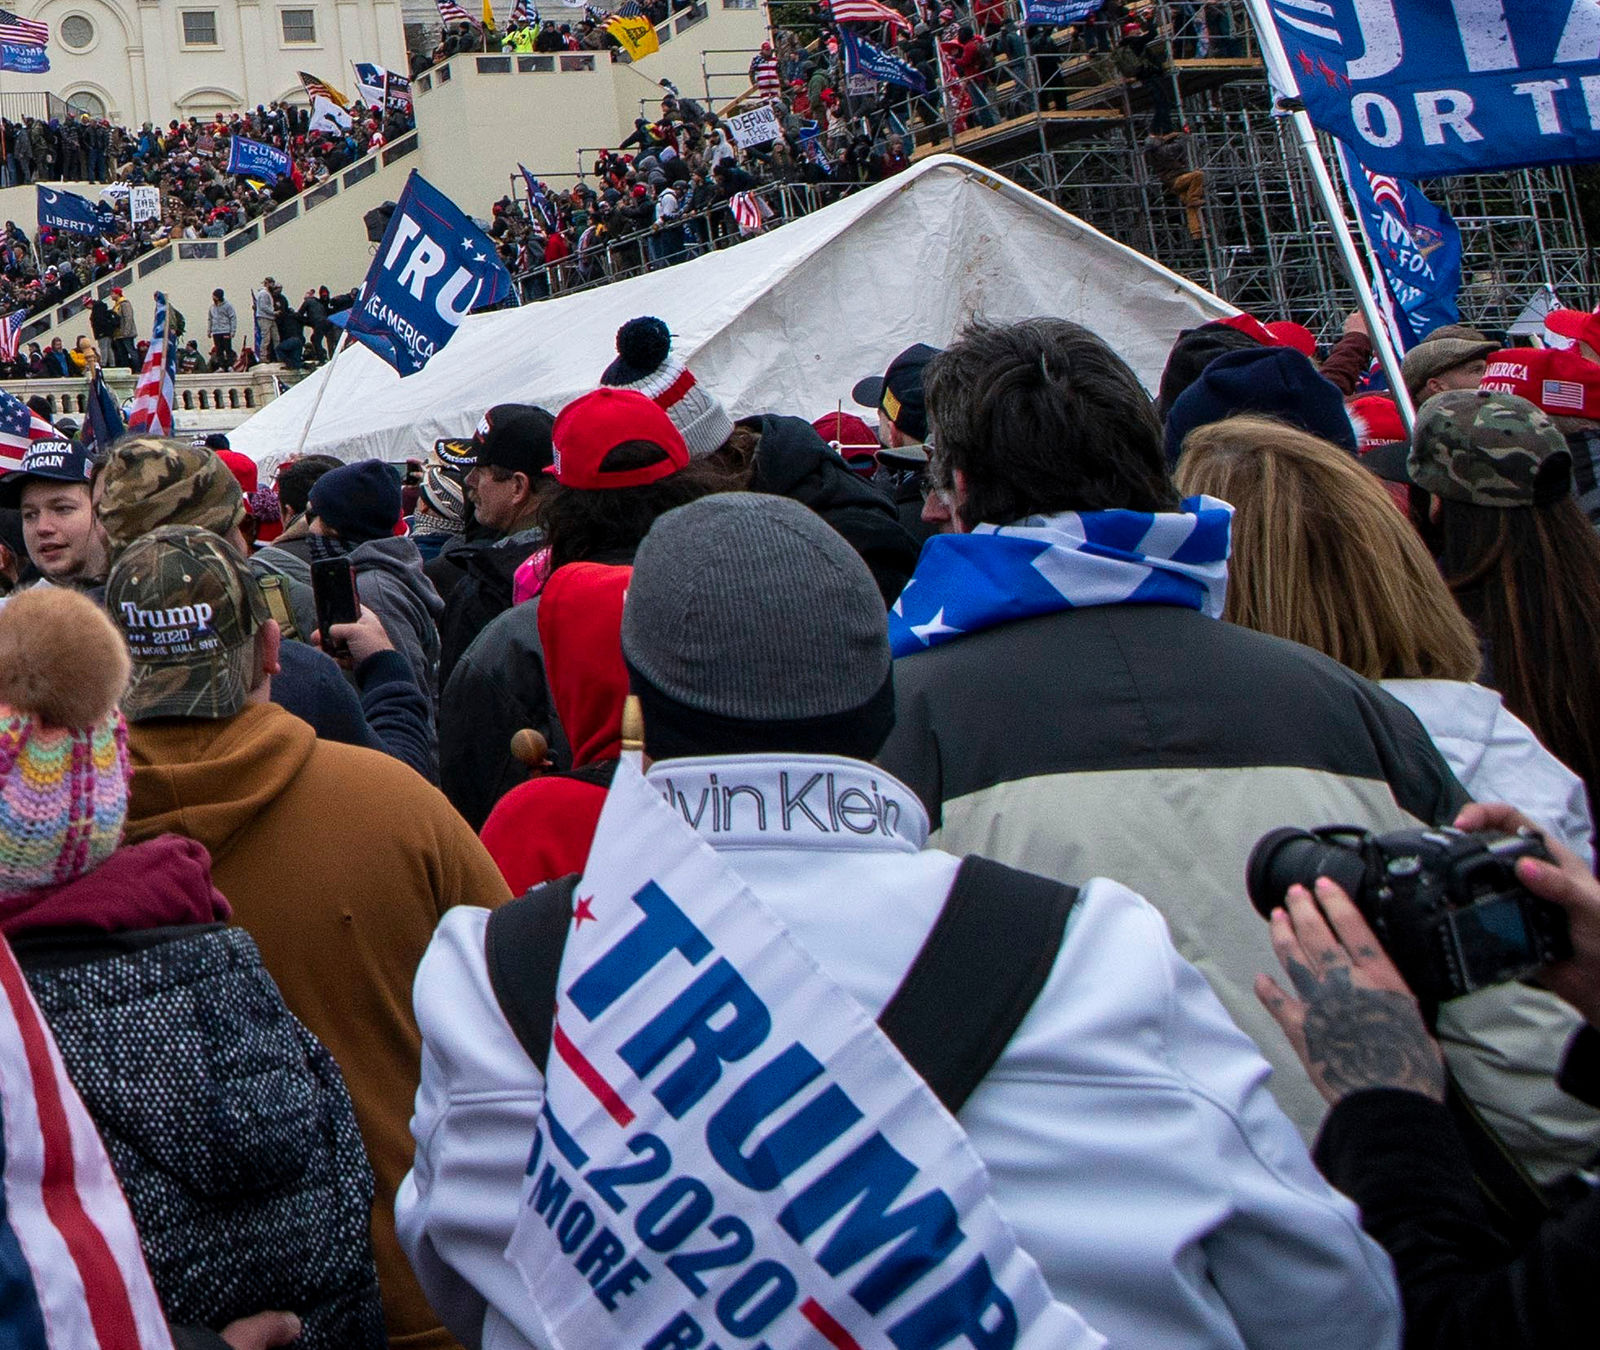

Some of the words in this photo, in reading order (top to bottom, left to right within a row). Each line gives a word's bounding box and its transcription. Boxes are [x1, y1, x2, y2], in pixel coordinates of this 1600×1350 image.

[2, 44, 43, 56] TRUMP
[731, 106, 775, 131] DEFUND
[742, 130, 778, 145] MEDIA
[744, 125, 768, 138] THE
[240, 142, 287, 165] TRUMP
[46, 214, 95, 232] LIBERTY
[384, 214, 484, 327] TRU
[378, 306, 435, 358] AMERICA
[29, 456, 65, 470] AGAIN
[121, 601, 213, 630] Trump
[142, 645, 167, 656] MORE
[171, 643, 195, 654] BULL
[199, 638, 218, 649] SHIT
[153, 628, 190, 644] 2020
[781, 771, 902, 837] Klein
[566, 879, 1020, 1350] TRUMP
[527, 1174, 652, 1313] MORE
[585, 1131, 799, 1343] 2020
